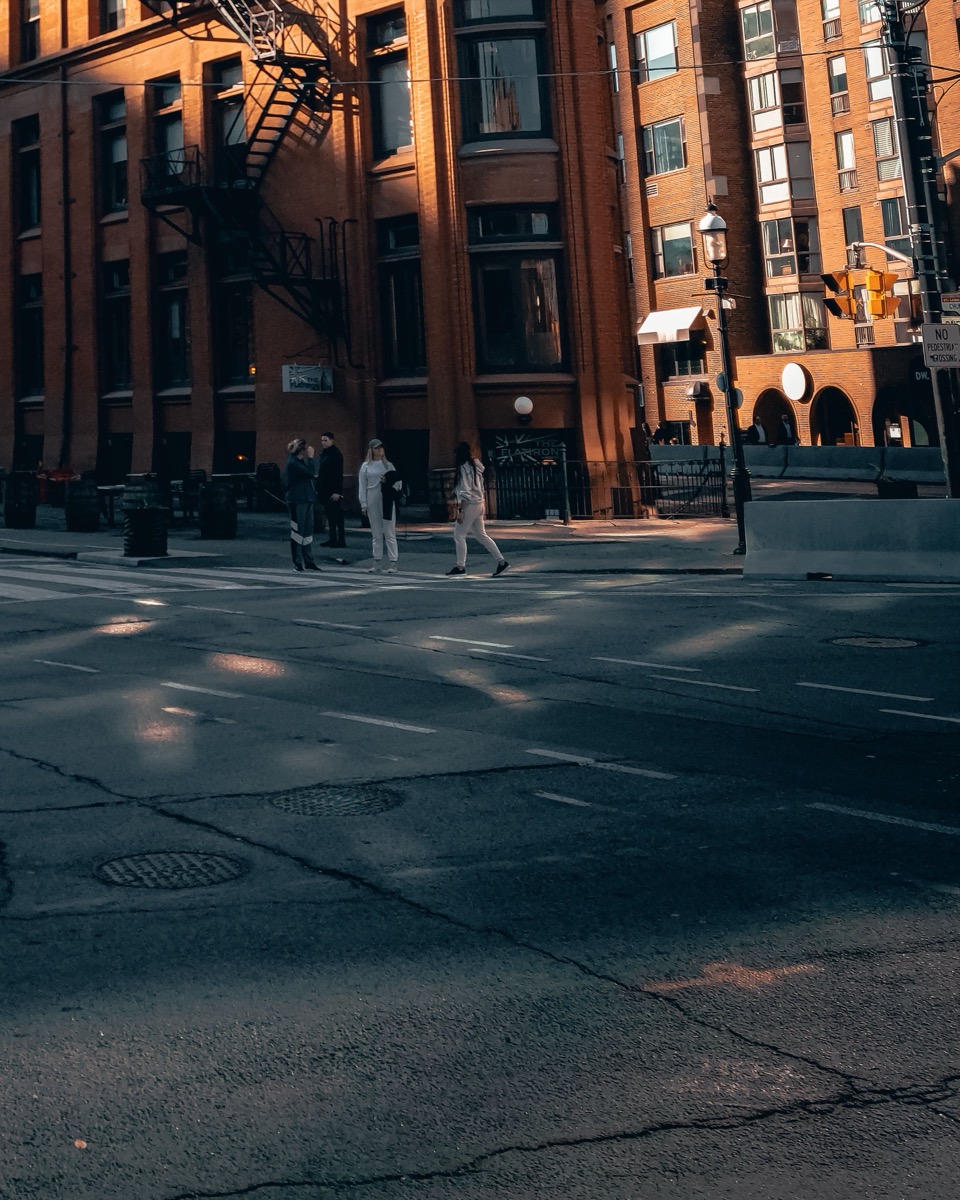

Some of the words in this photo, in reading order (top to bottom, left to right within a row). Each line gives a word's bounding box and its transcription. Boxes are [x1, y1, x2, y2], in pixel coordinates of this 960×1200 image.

[935, 329, 948, 340] NO
[927, 343, 958, 352] PEDESTRIA
[501, 448, 559, 456] FLATIRON
